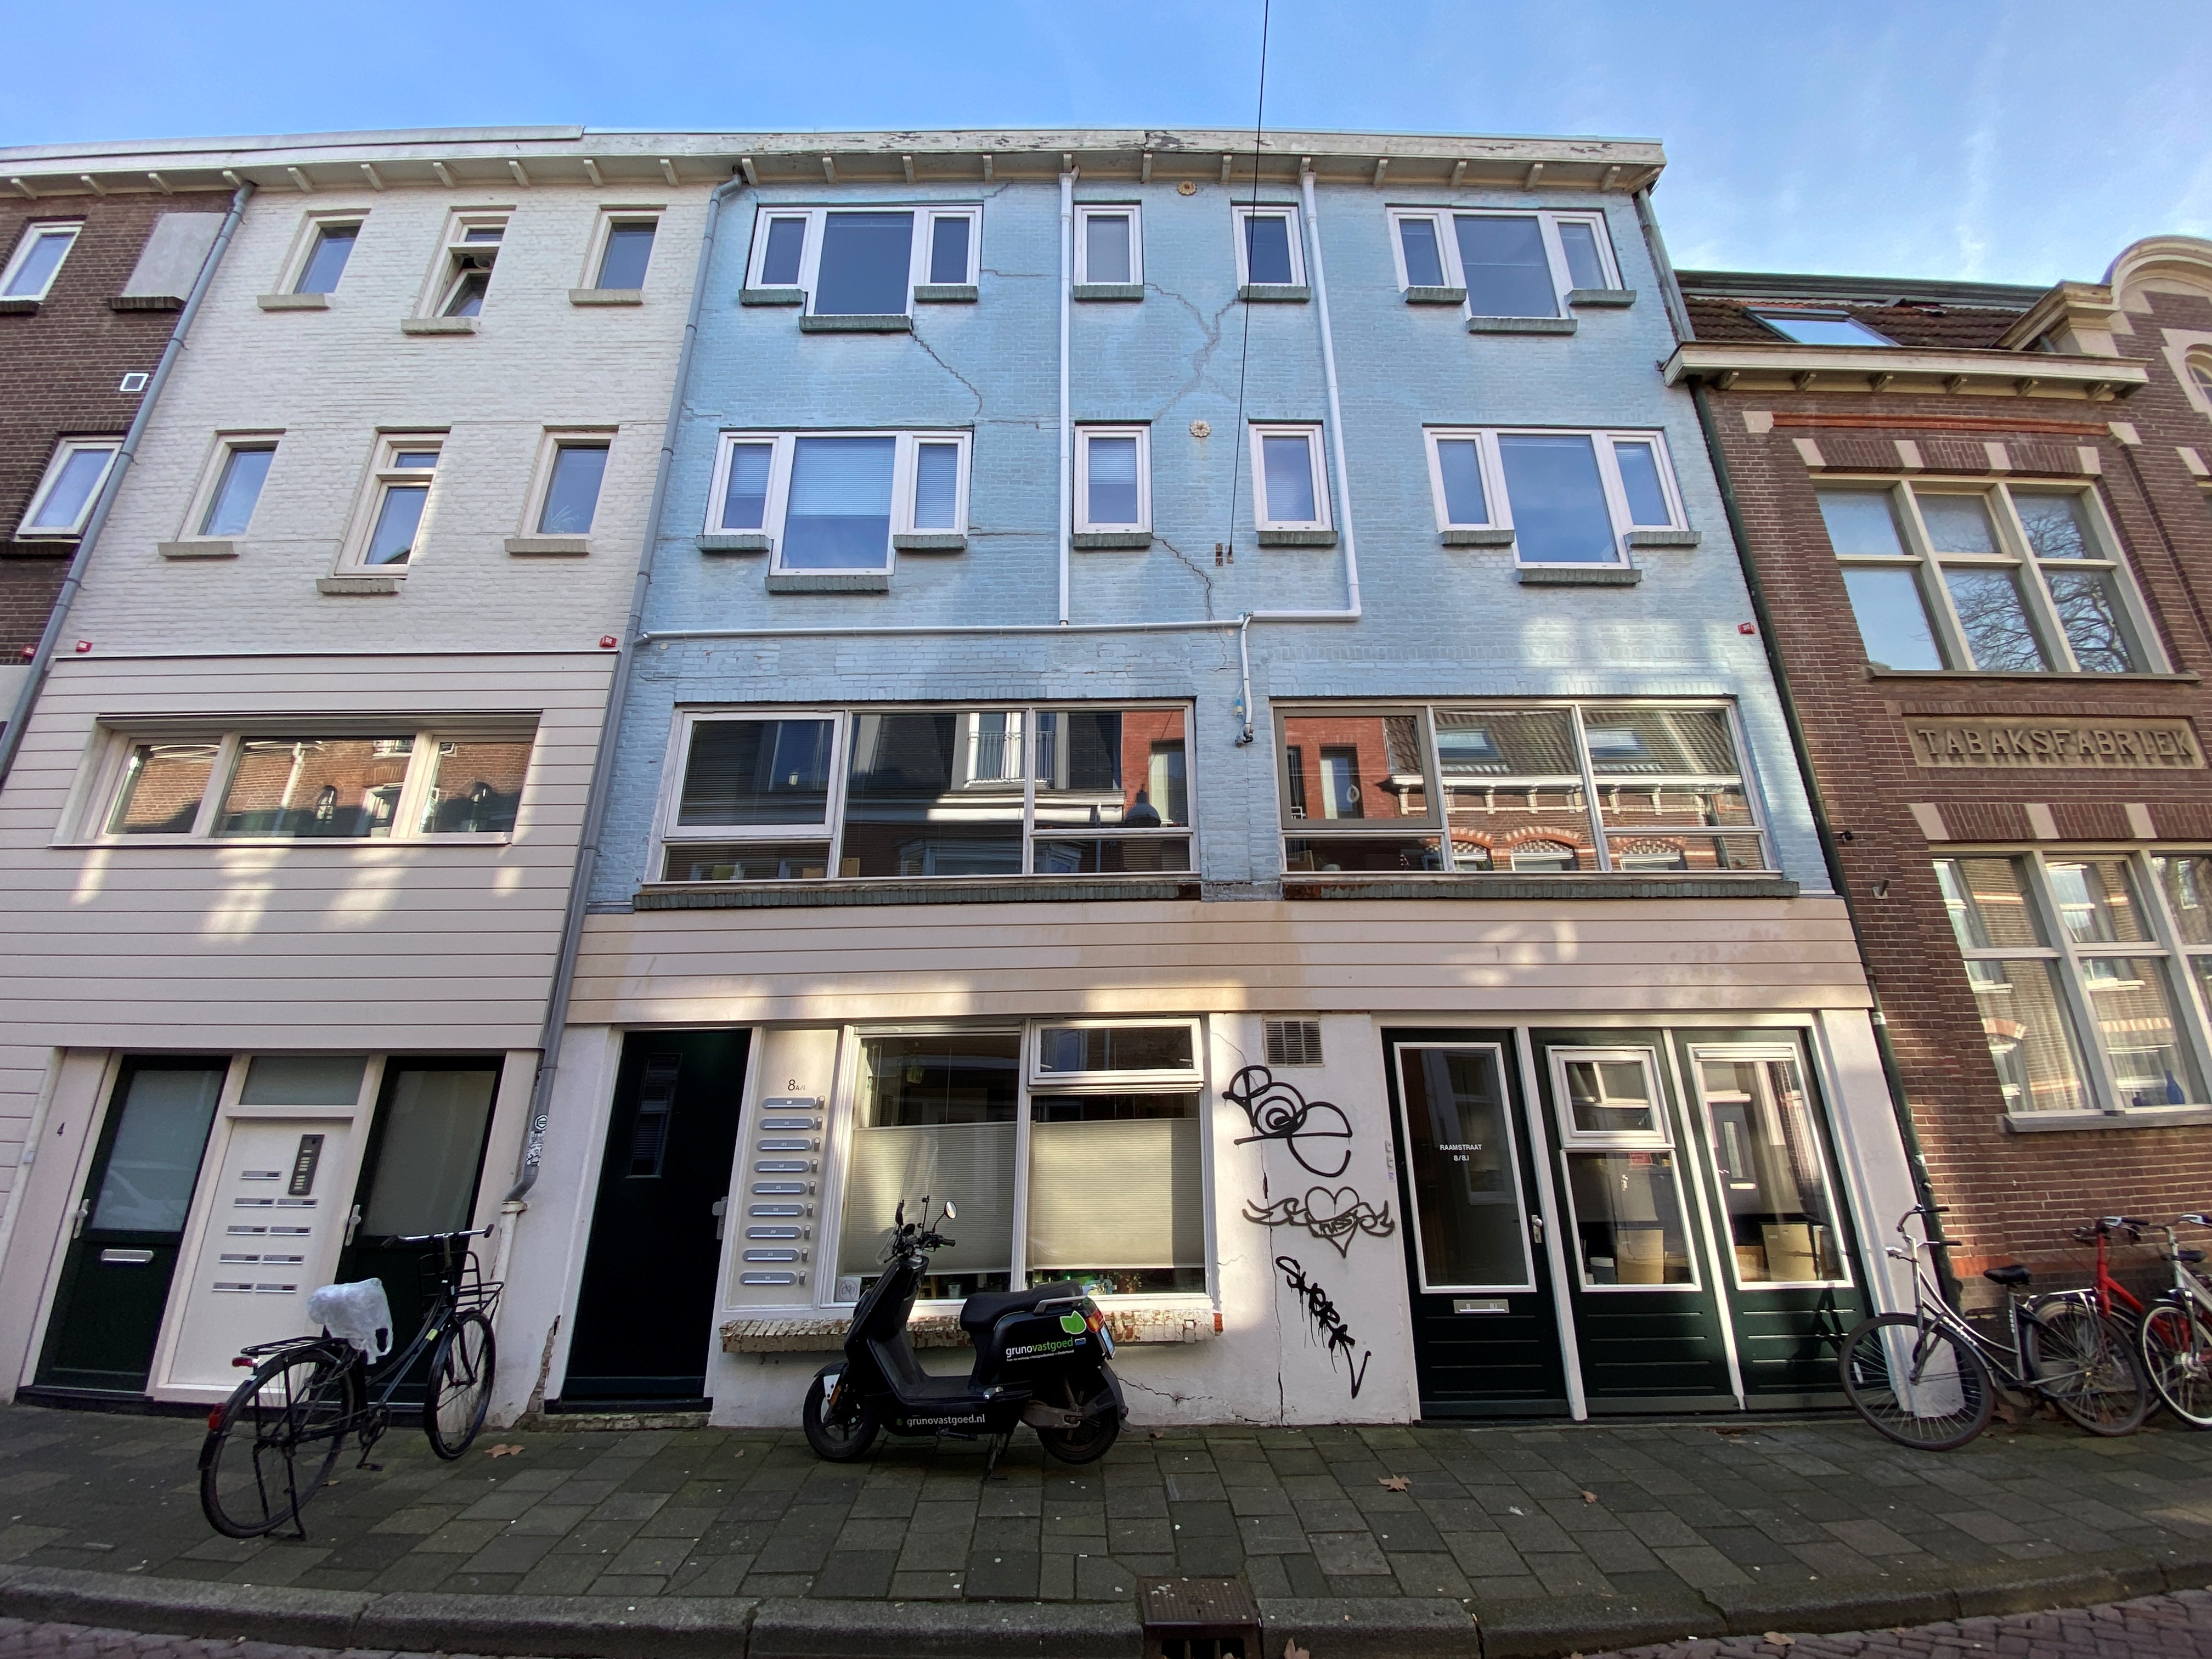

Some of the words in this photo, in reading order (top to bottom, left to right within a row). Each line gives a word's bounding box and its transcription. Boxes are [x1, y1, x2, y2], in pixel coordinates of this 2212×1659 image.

[1917, 728, 2193, 756] TABAKSFABRIEK
[57, 1122, 65, 1137] 4
[1006, 1337, 1073, 1358] grunovastgoed
[907, 1414, 985, 1427] grunovastgoed.nl
